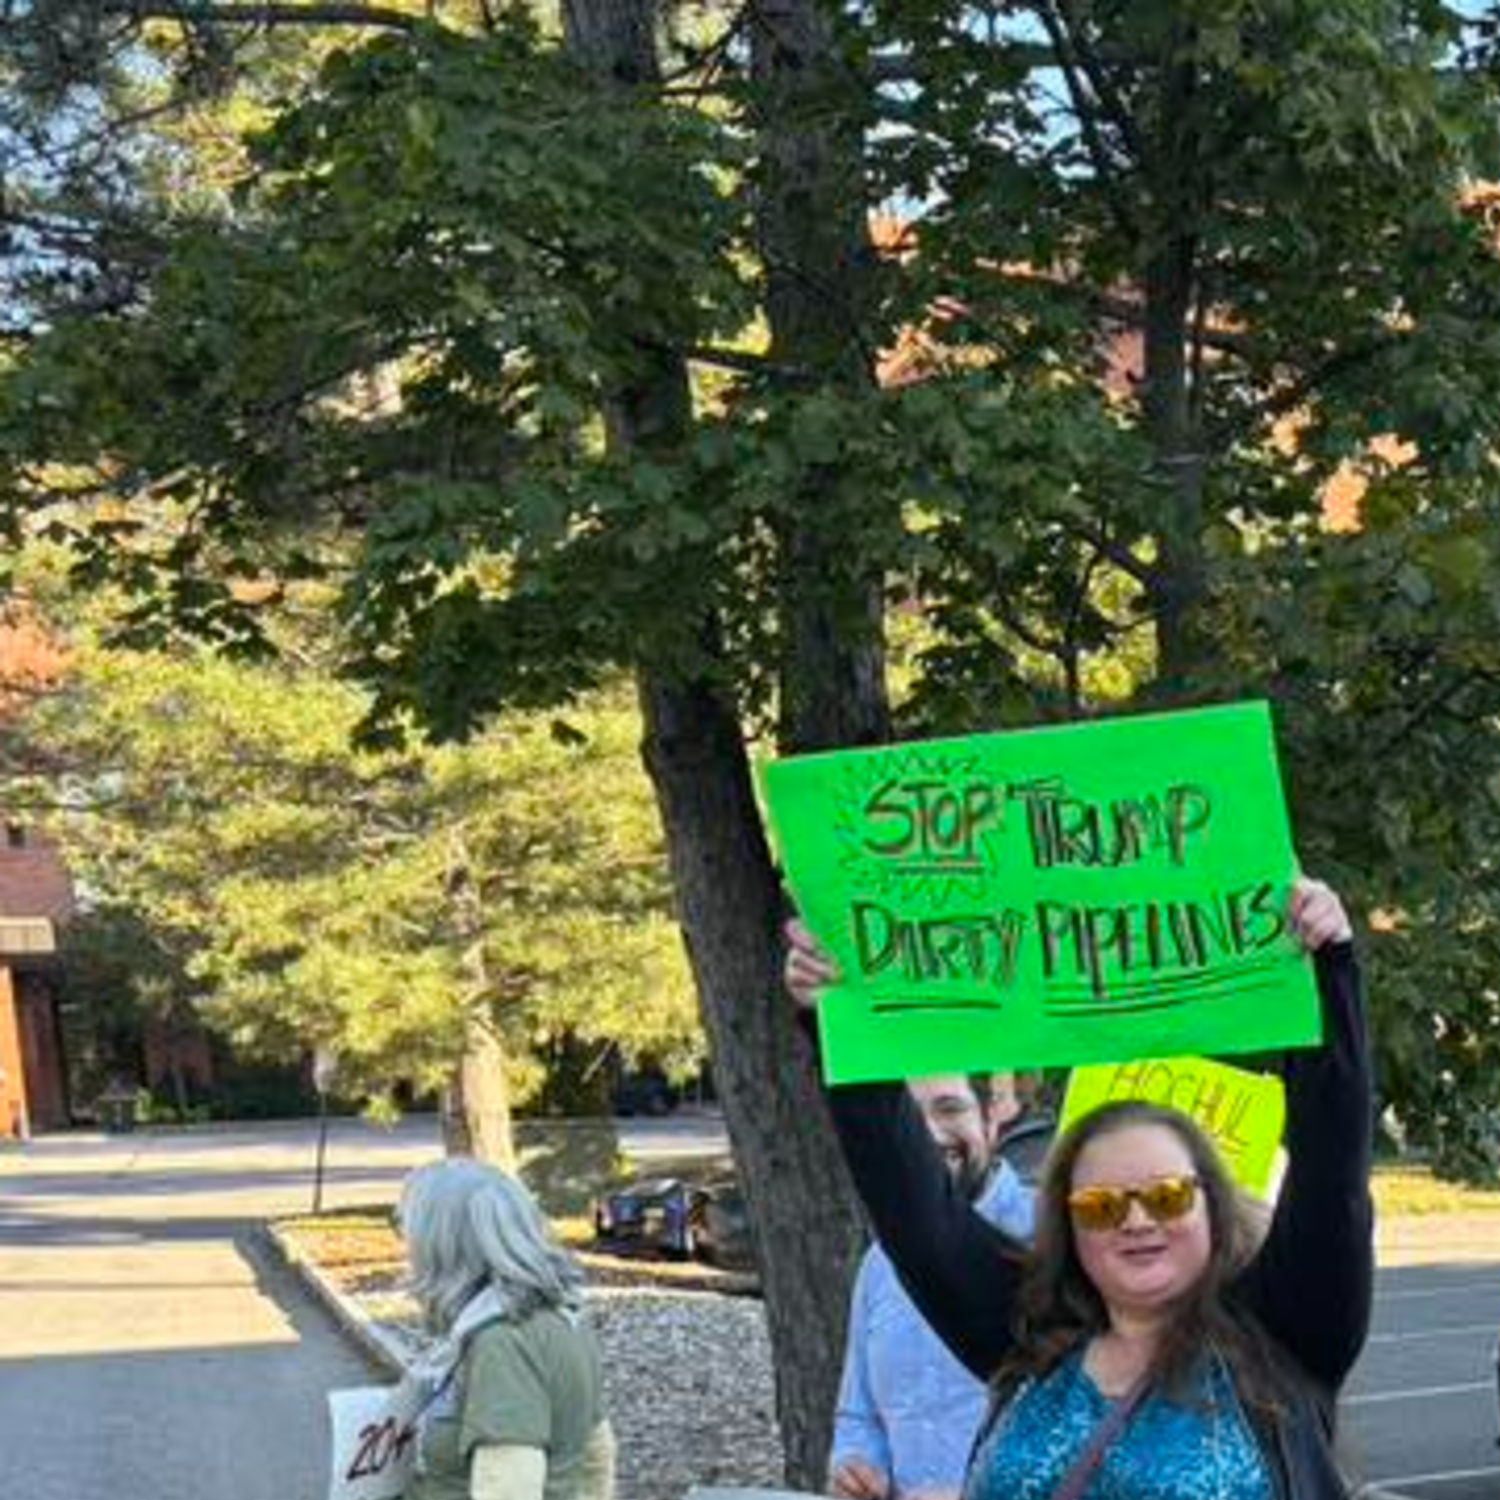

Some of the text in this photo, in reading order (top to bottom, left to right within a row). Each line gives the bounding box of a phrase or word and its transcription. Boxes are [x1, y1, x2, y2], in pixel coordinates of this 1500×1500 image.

[863, 778, 1213, 868] STOP TRUMP
[852, 883, 1286, 999] DIRTY PIPELINES
